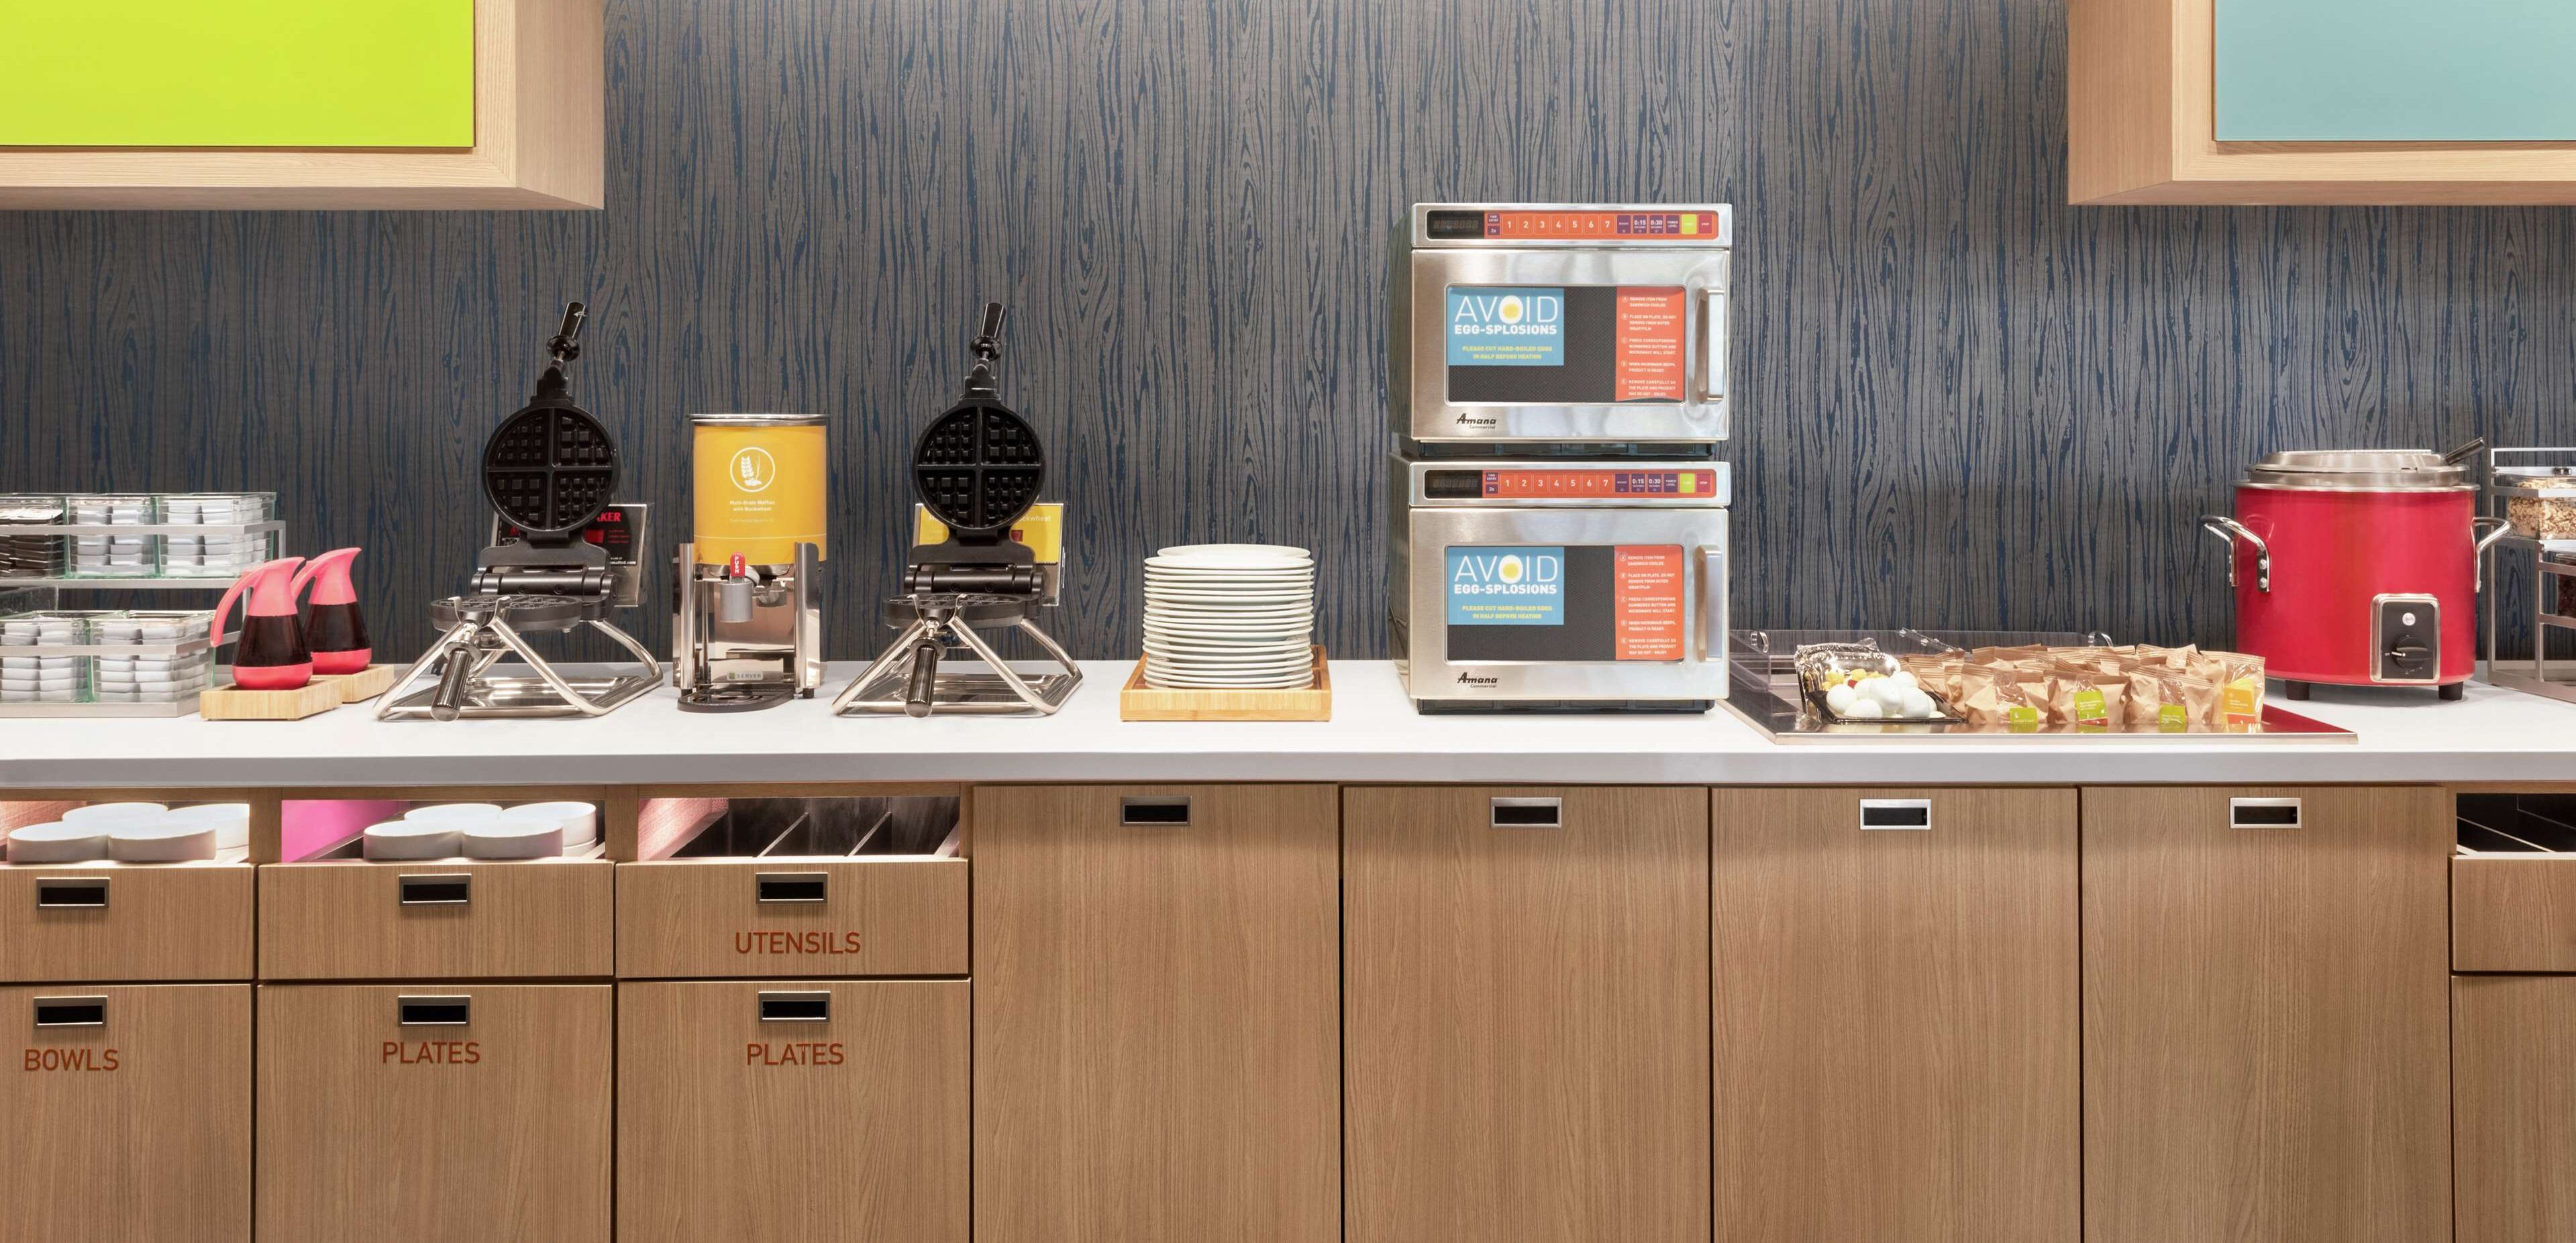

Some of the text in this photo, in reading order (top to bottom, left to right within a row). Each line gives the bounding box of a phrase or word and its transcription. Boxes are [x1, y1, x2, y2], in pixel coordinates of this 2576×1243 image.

[1455, 295, 1558, 324] AVOID
[1454, 325, 1557, 334] EGG-SPLOSIONS
[1456, 413, 1496, 424] Amana
[1455, 555, 1558, 584] AVOID
[1454, 584, 1557, 594] EGG-SPLOSIONS
[1457, 672, 1498, 683] Amana
[735, 931, 861, 954] UTENSILS
[24, 1049, 119, 1071] BOWLS
[382, 1042, 480, 1064] PLATES
[746, 1043, 845, 1066] PLATES
